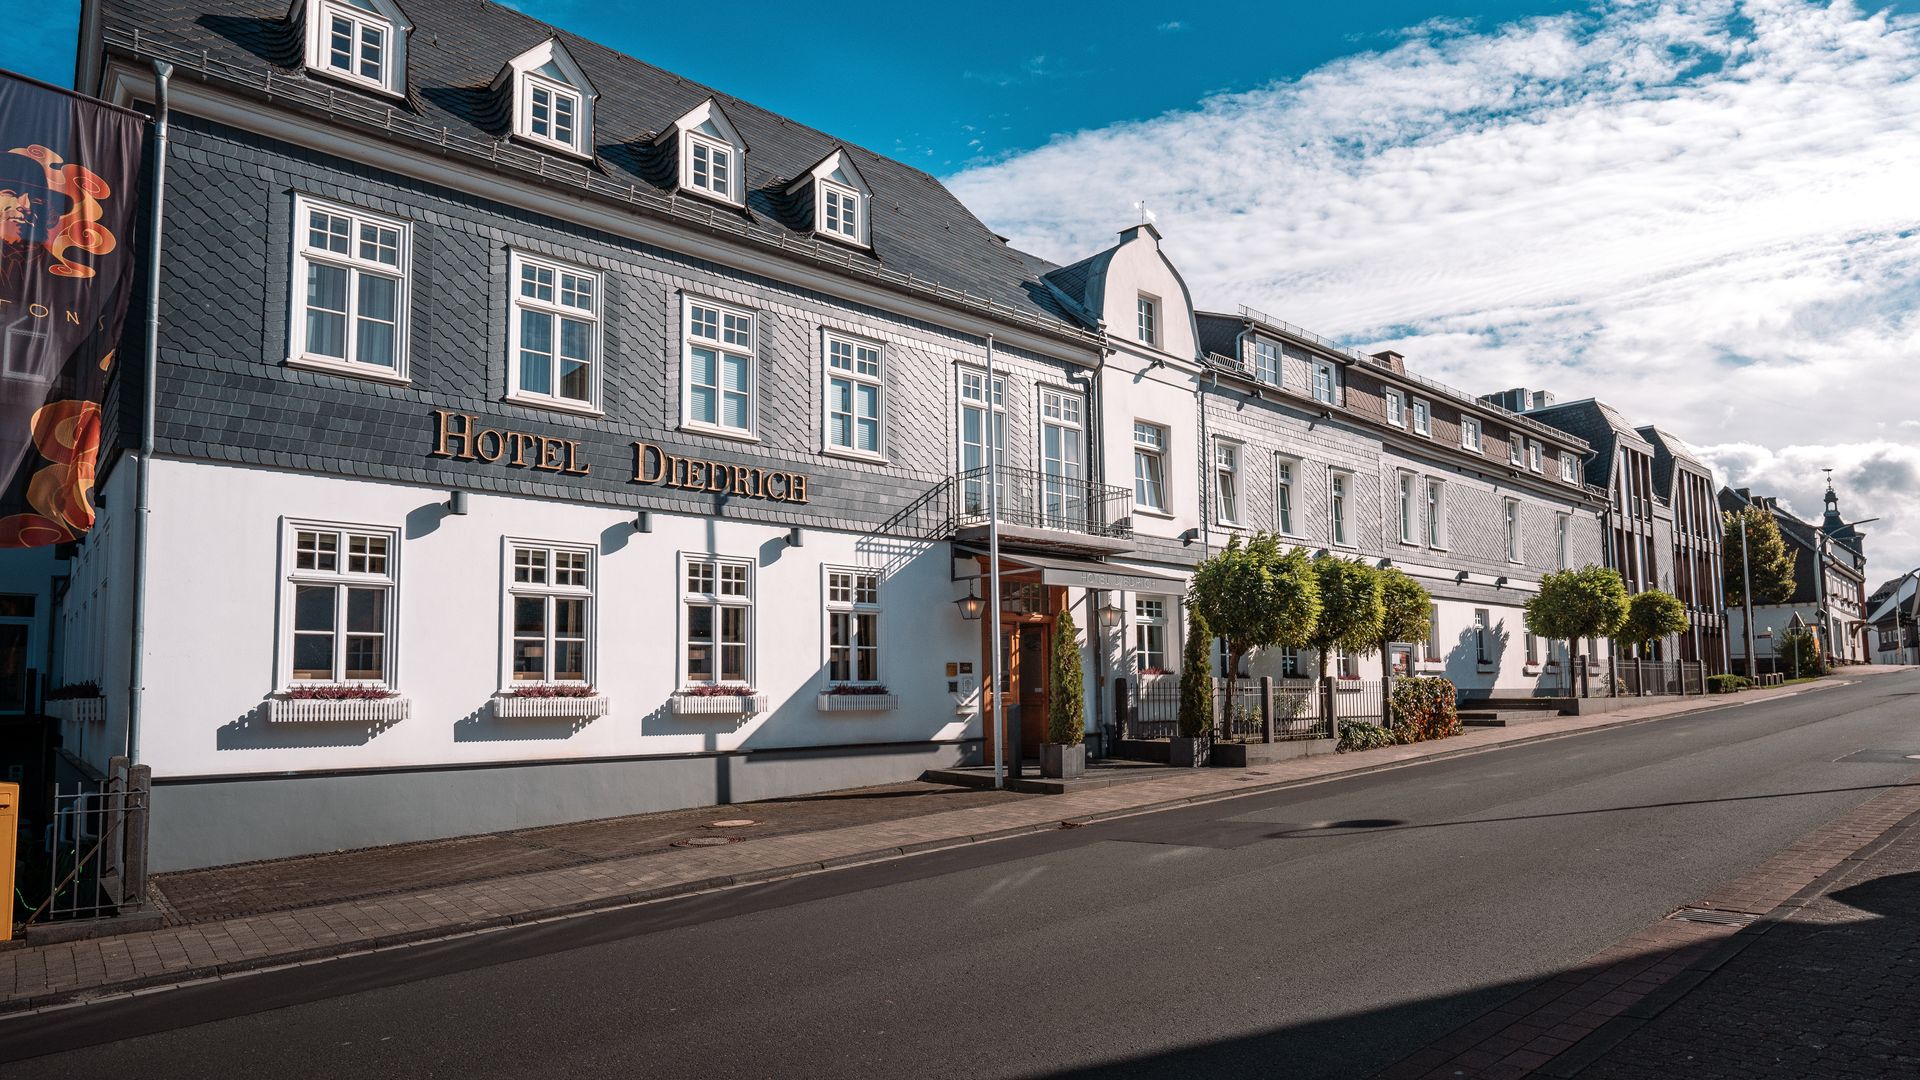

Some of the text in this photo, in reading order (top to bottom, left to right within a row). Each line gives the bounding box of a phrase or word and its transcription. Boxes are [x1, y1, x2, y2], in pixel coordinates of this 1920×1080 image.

[433, 409, 810, 502] HOTEL DIEDRICH
[1081, 571, 1157, 589] HOTEL DIEDRICH
